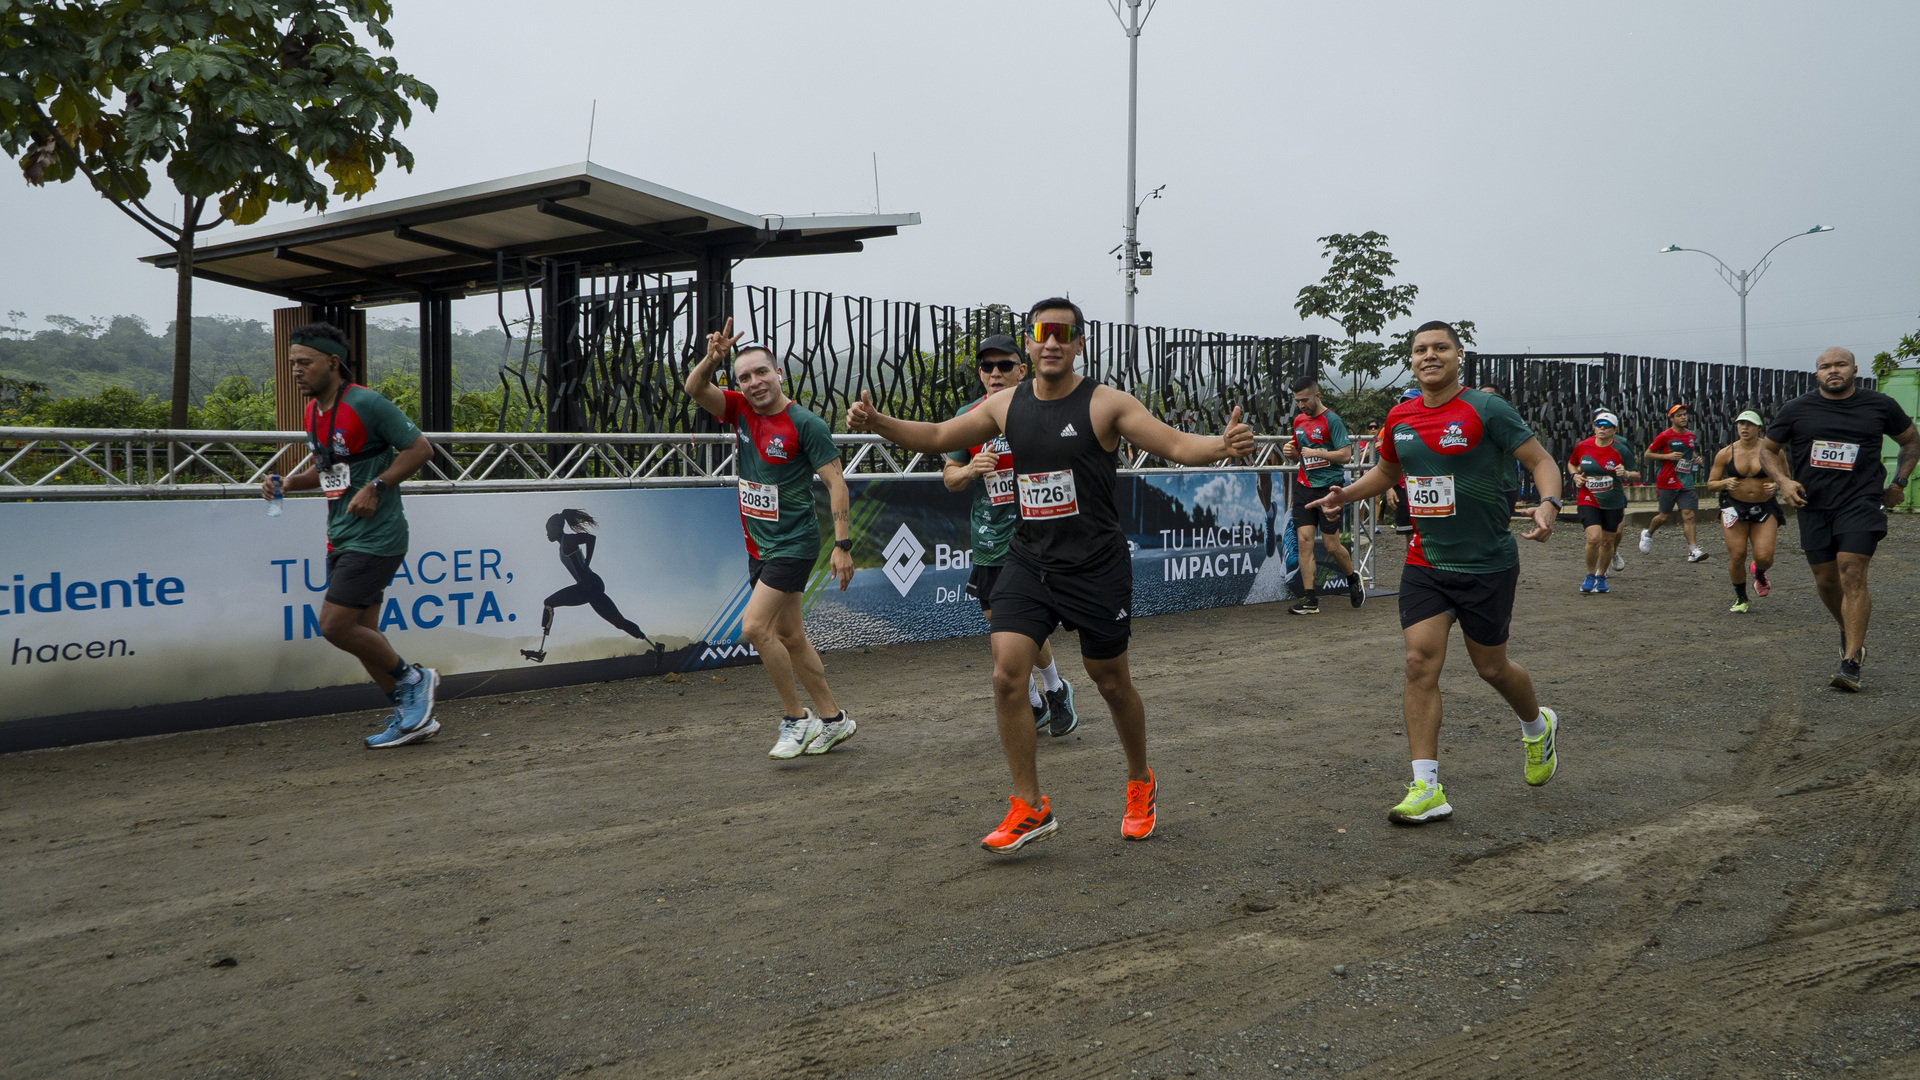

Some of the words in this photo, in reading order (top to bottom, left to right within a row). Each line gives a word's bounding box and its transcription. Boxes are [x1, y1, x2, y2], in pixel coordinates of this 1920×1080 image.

[1821, 449, 1845, 461] 501
[991, 480, 1014, 494] 108
[1027, 486, 1064, 504] 1726
[742, 491, 770, 508] 2083
[1414, 489, 1439, 504] 450
[1159, 528, 1184, 552] TU
[1192, 525, 1258, 550] HACER,
[270, 558, 329, 594] TU
[386, 548, 514, 587] ACER,
[1164, 552, 1259, 582] IMPACTA.
[935, 584, 961, 603] Del
[707, 638, 732, 646] Grupo
[11, 637, 136, 666] hacen.
